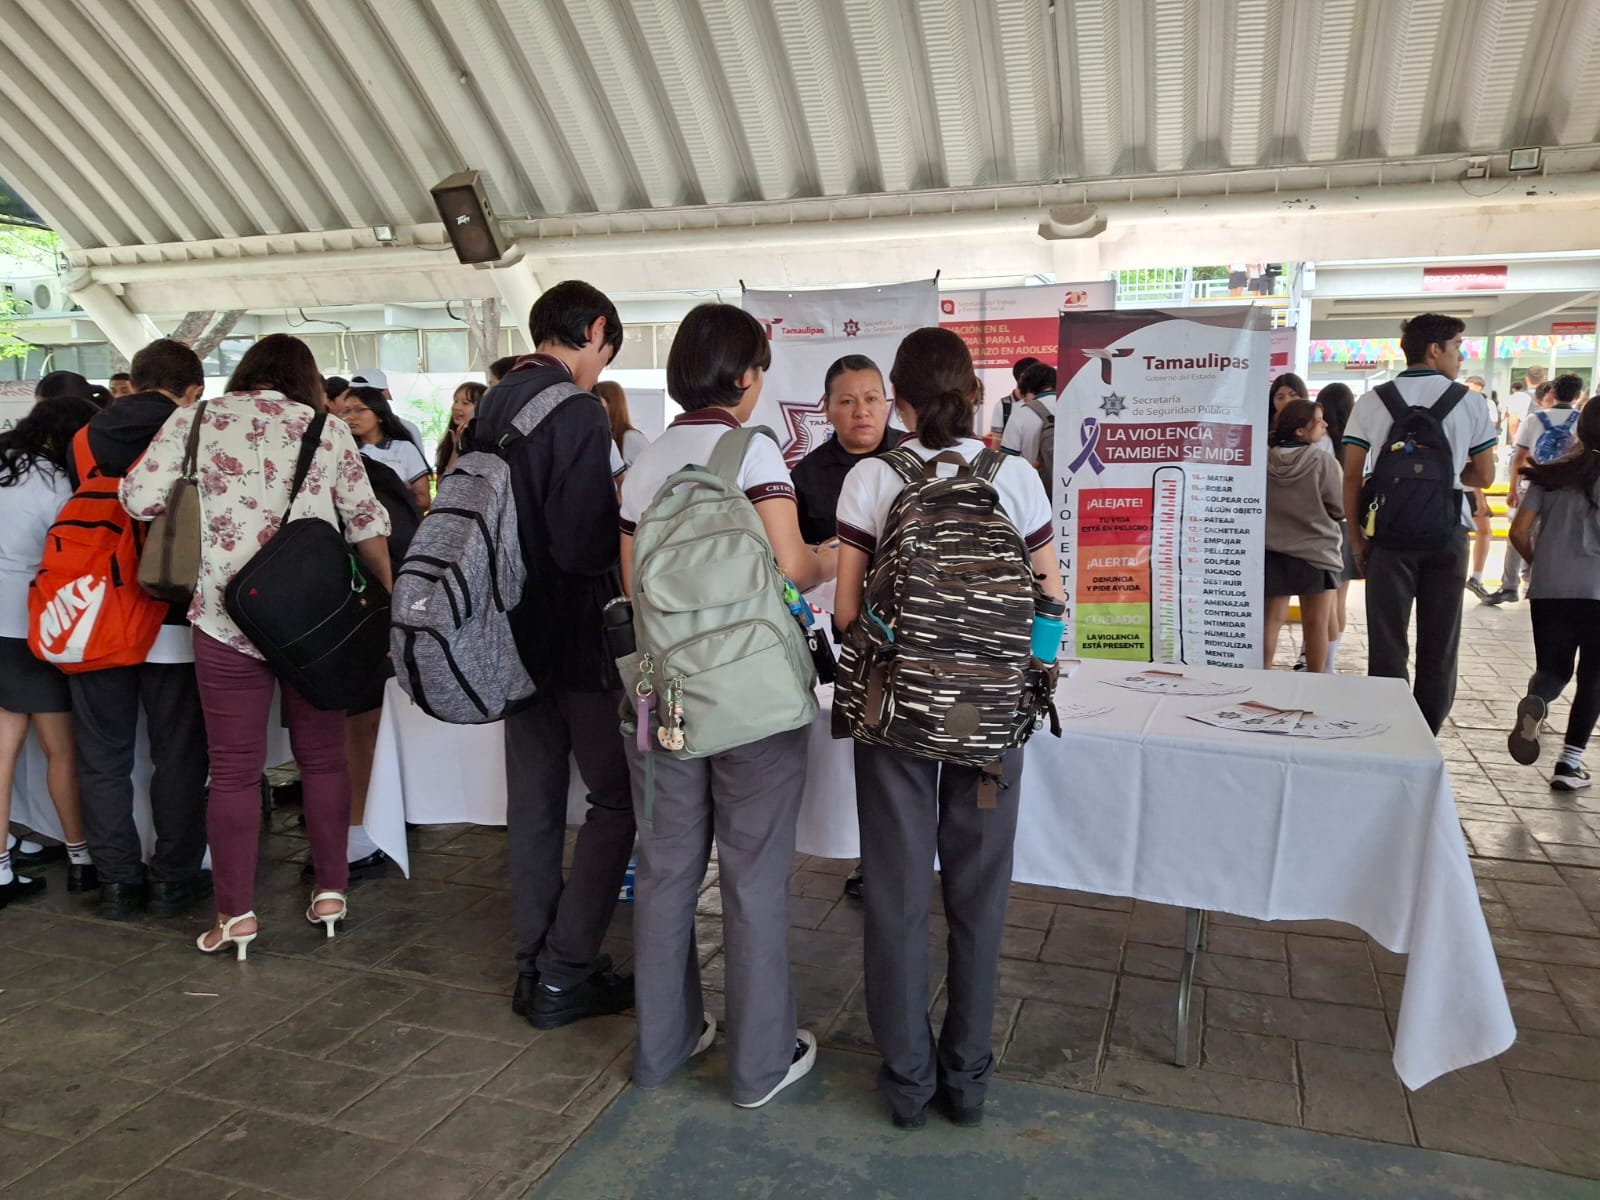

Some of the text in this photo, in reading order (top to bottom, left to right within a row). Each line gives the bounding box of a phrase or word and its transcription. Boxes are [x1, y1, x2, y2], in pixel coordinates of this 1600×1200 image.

[782, 326, 824, 335] Tamaulipas
[984, 325, 996, 333] EN
[999, 324, 1010, 333] EL
[986, 336, 1010, 344] PARA
[1001, 347, 1014, 355] EN
[1142, 353, 1249, 371] Tamaulipas
[1132, 394, 1181, 405] Secretaría
[1132, 405, 1231, 418] de Seguridad Pública
[1106, 426, 1213, 441] LA VIOLENCIA
[1106, 443, 1244, 462] TAMBIÉN SE MIDE
[1087, 498, 1143, 510] ¡ALEJATE!
[1203, 588, 1246, 597] ARTÍCULOS
[40, 574, 101, 648] NIKE
[1205, 640, 1253, 649] RIDICULIZAR
